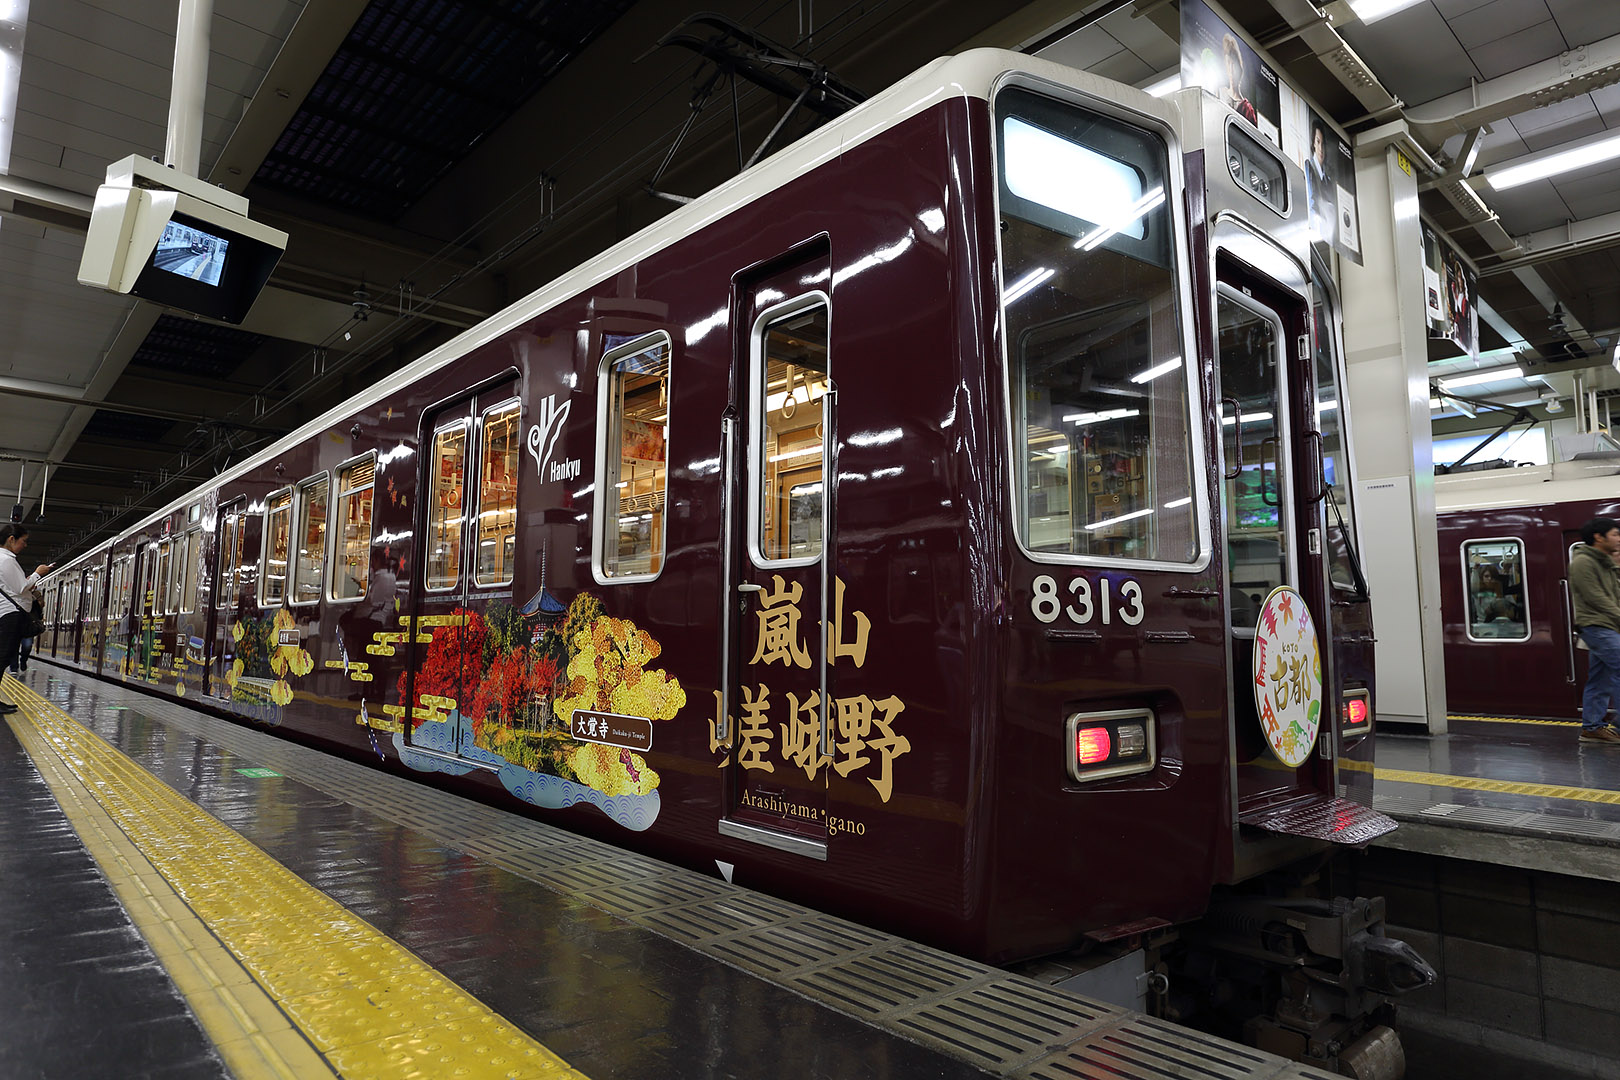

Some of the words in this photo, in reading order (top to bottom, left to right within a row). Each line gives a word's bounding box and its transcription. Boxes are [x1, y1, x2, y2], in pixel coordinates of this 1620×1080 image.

[550, 457, 581, 482] Hankyu
[748, 574, 872, 669] 嵐山
[1031, 574, 1145, 626] 8313
[1269, 654, 1312, 714] 古都
[707, 682, 912, 803] 嵯峨野
